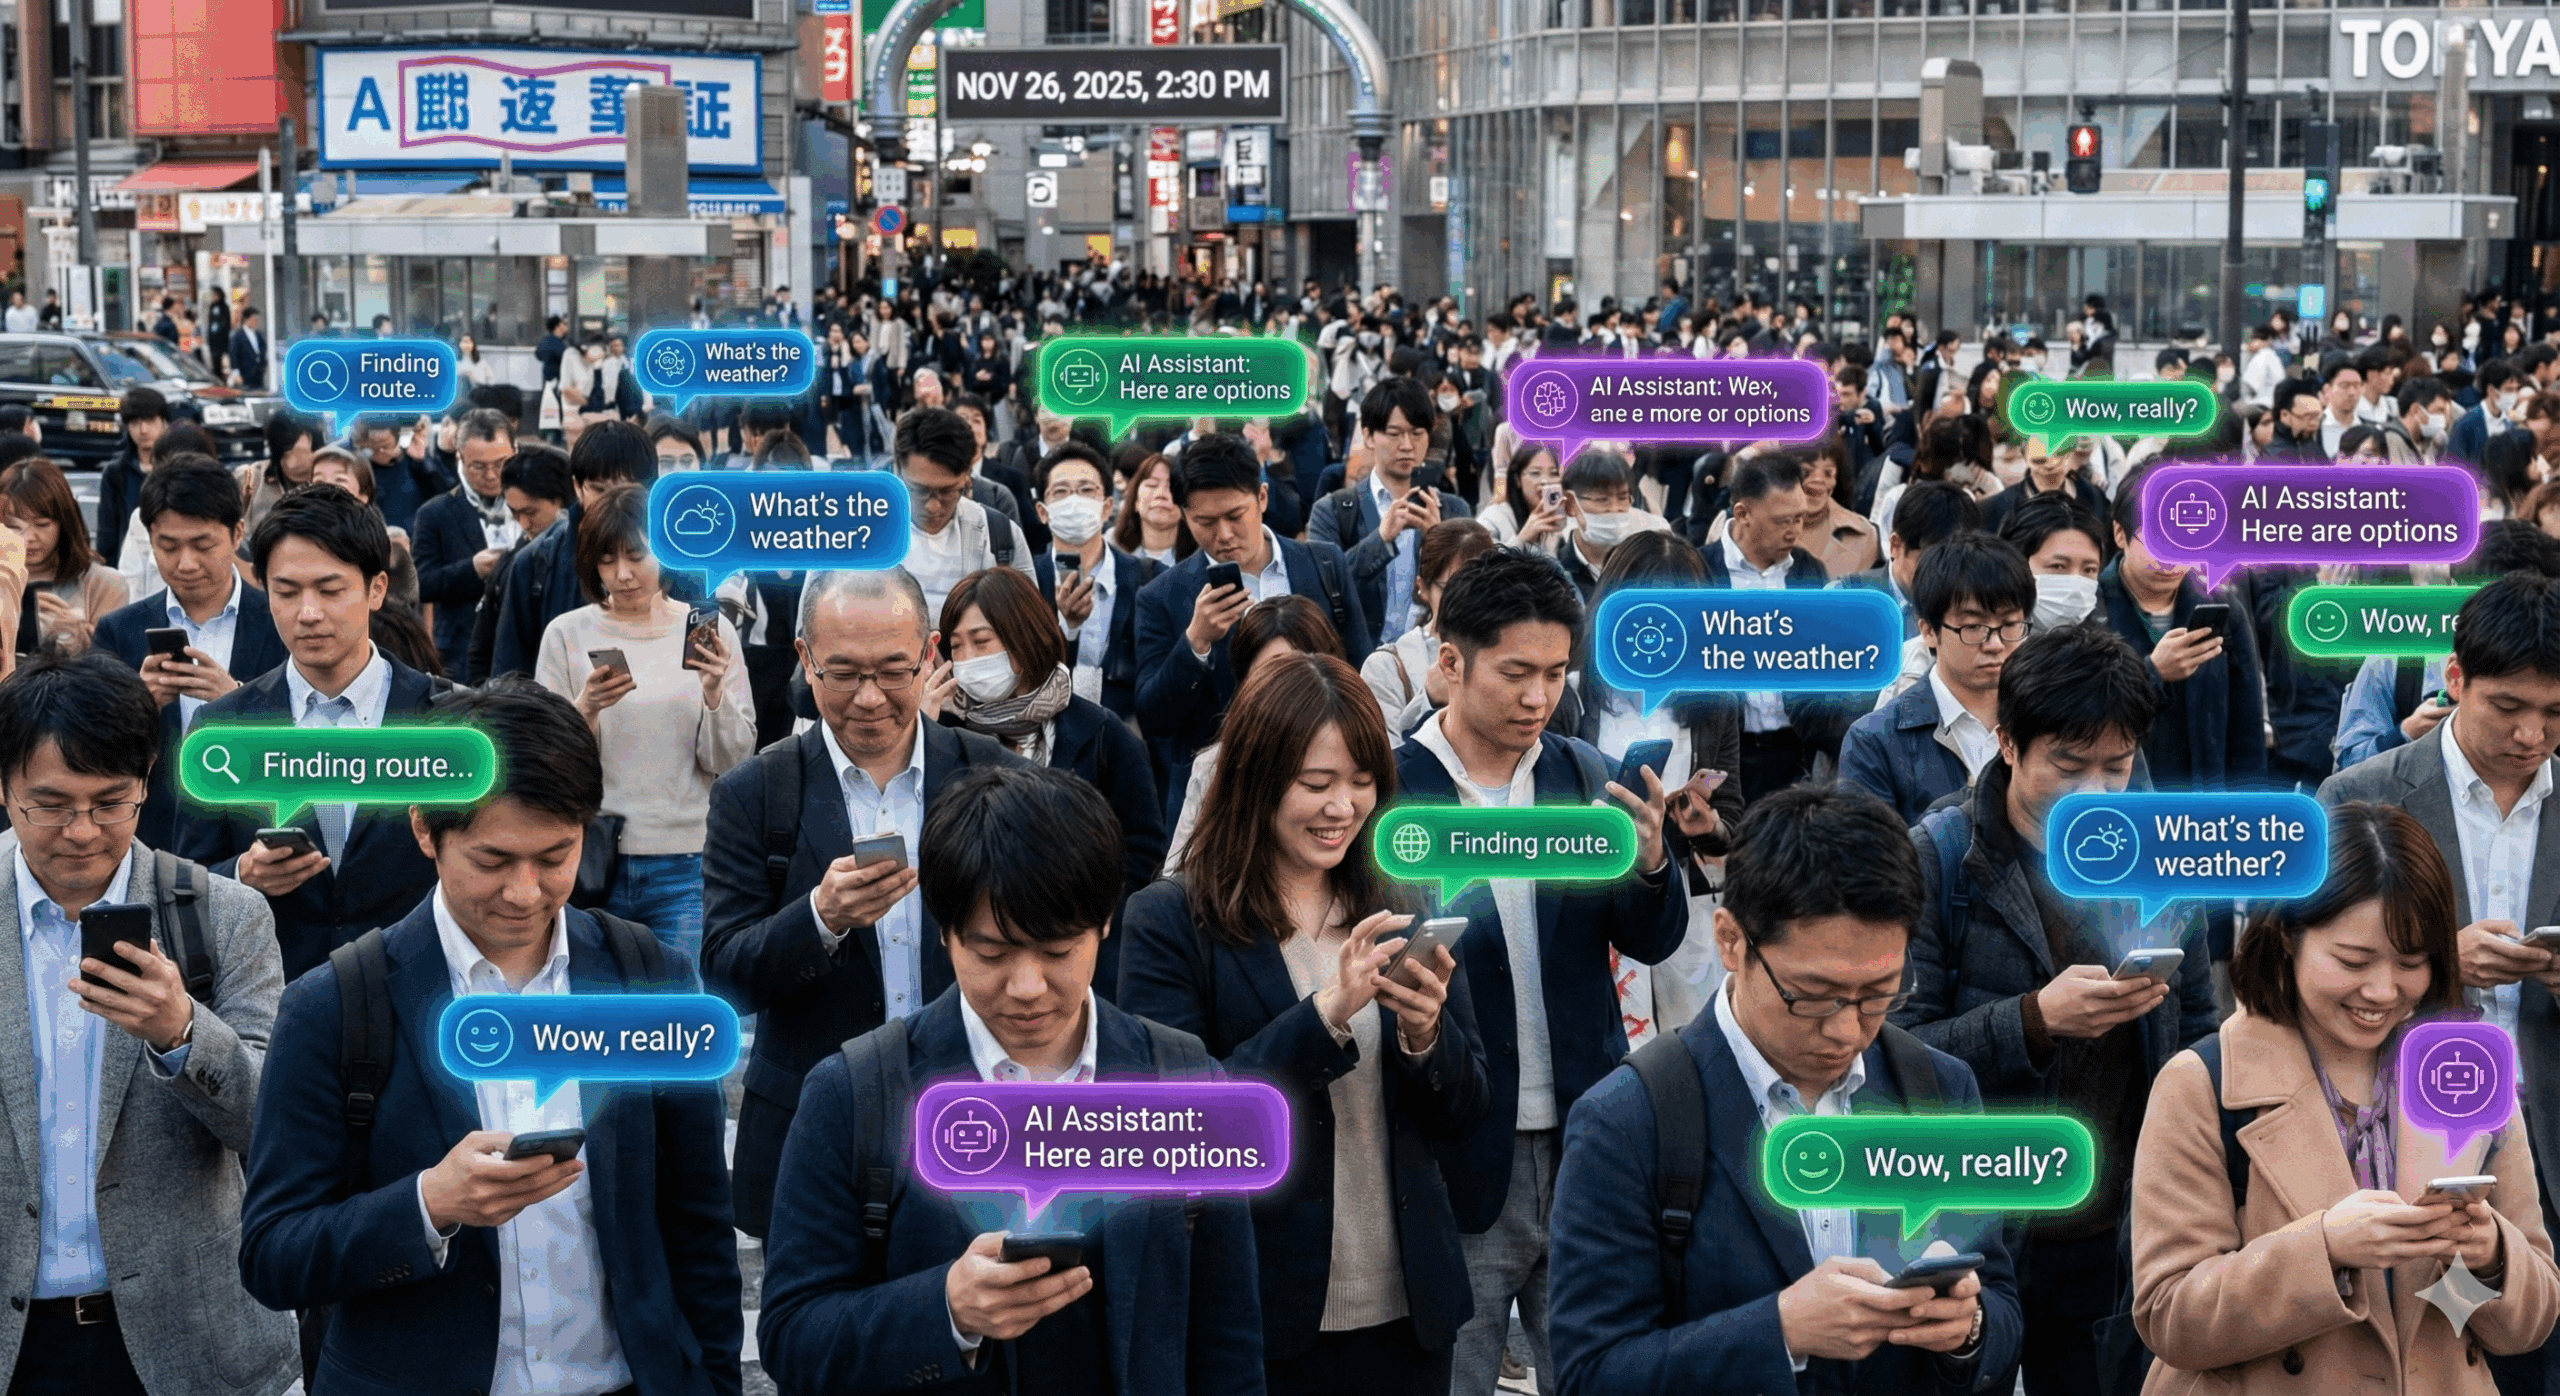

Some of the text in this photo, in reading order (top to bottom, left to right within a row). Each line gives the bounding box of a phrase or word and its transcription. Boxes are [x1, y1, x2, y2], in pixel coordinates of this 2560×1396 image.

[347, 76, 392, 132] A
[957, 69, 1270, 104] NOV 26, 2025, 2:30 PM
